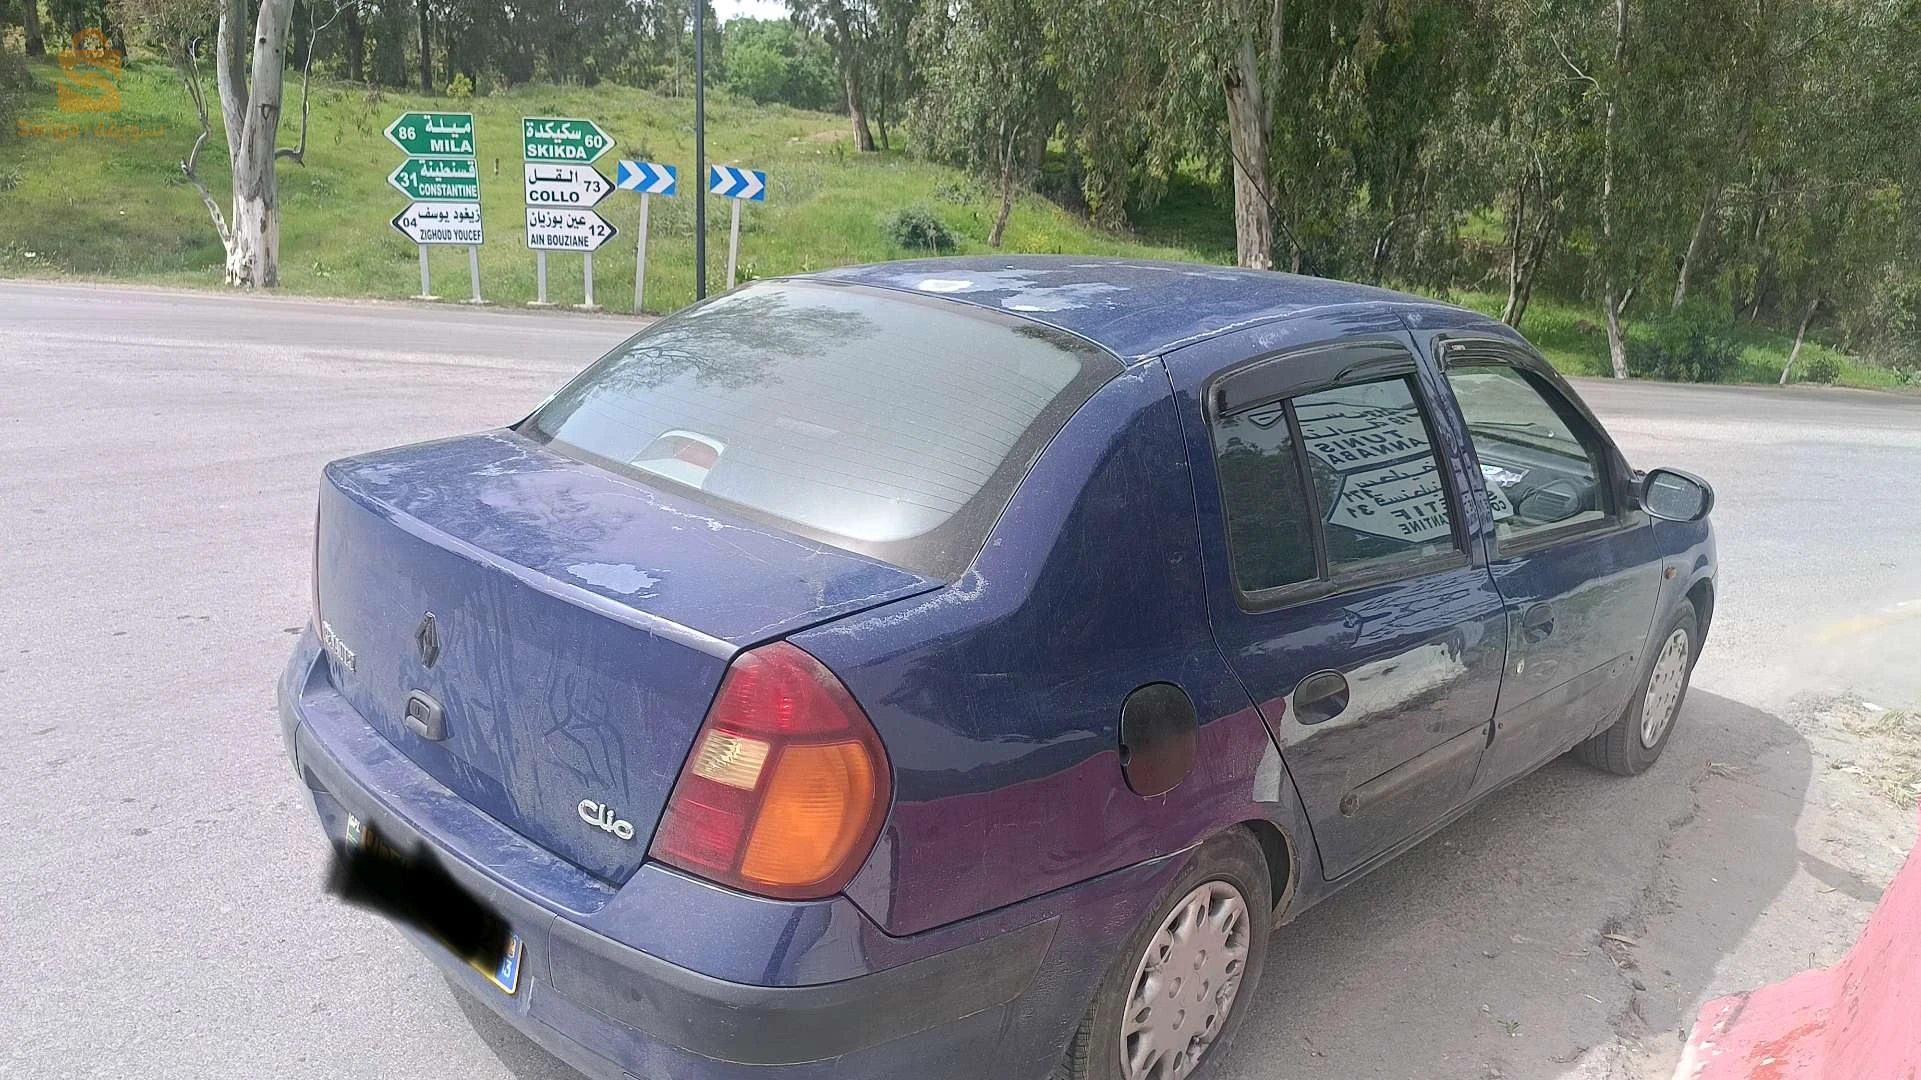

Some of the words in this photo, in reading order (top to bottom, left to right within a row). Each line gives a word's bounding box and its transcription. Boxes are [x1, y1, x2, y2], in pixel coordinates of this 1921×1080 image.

[399, 126, 416, 140] 86
[424, 114, 471, 138] ميلة
[526, 121, 581, 143] سكيكدة
[430, 139, 472, 152] MILA
[584, 135, 603, 148] 60
[527, 144, 587, 159] SKIKDA
[419, 160, 476, 182] قسنطينة
[529, 168, 578, 184] القل
[400, 172, 418, 187] 31
[584, 181, 601, 192] 73
[418, 183, 478, 197] CONSTANTINE
[529, 190, 580, 203] COLLO
[418, 207, 450, 223] يوسف
[453, 207, 480, 223] زيغود
[529, 211, 563, 229] بوزيان
[566, 214, 586, 229] عين
[403, 218, 417, 228] 04
[588, 225, 605, 236] 12
[420, 229, 452, 240] ZIGHOUD
[453, 229, 481, 241] YOUCEF
[530, 234, 545, 245] AIN
[547, 234, 589, 247] BOUZIANE
[577, 798, 635, 840] Clio
